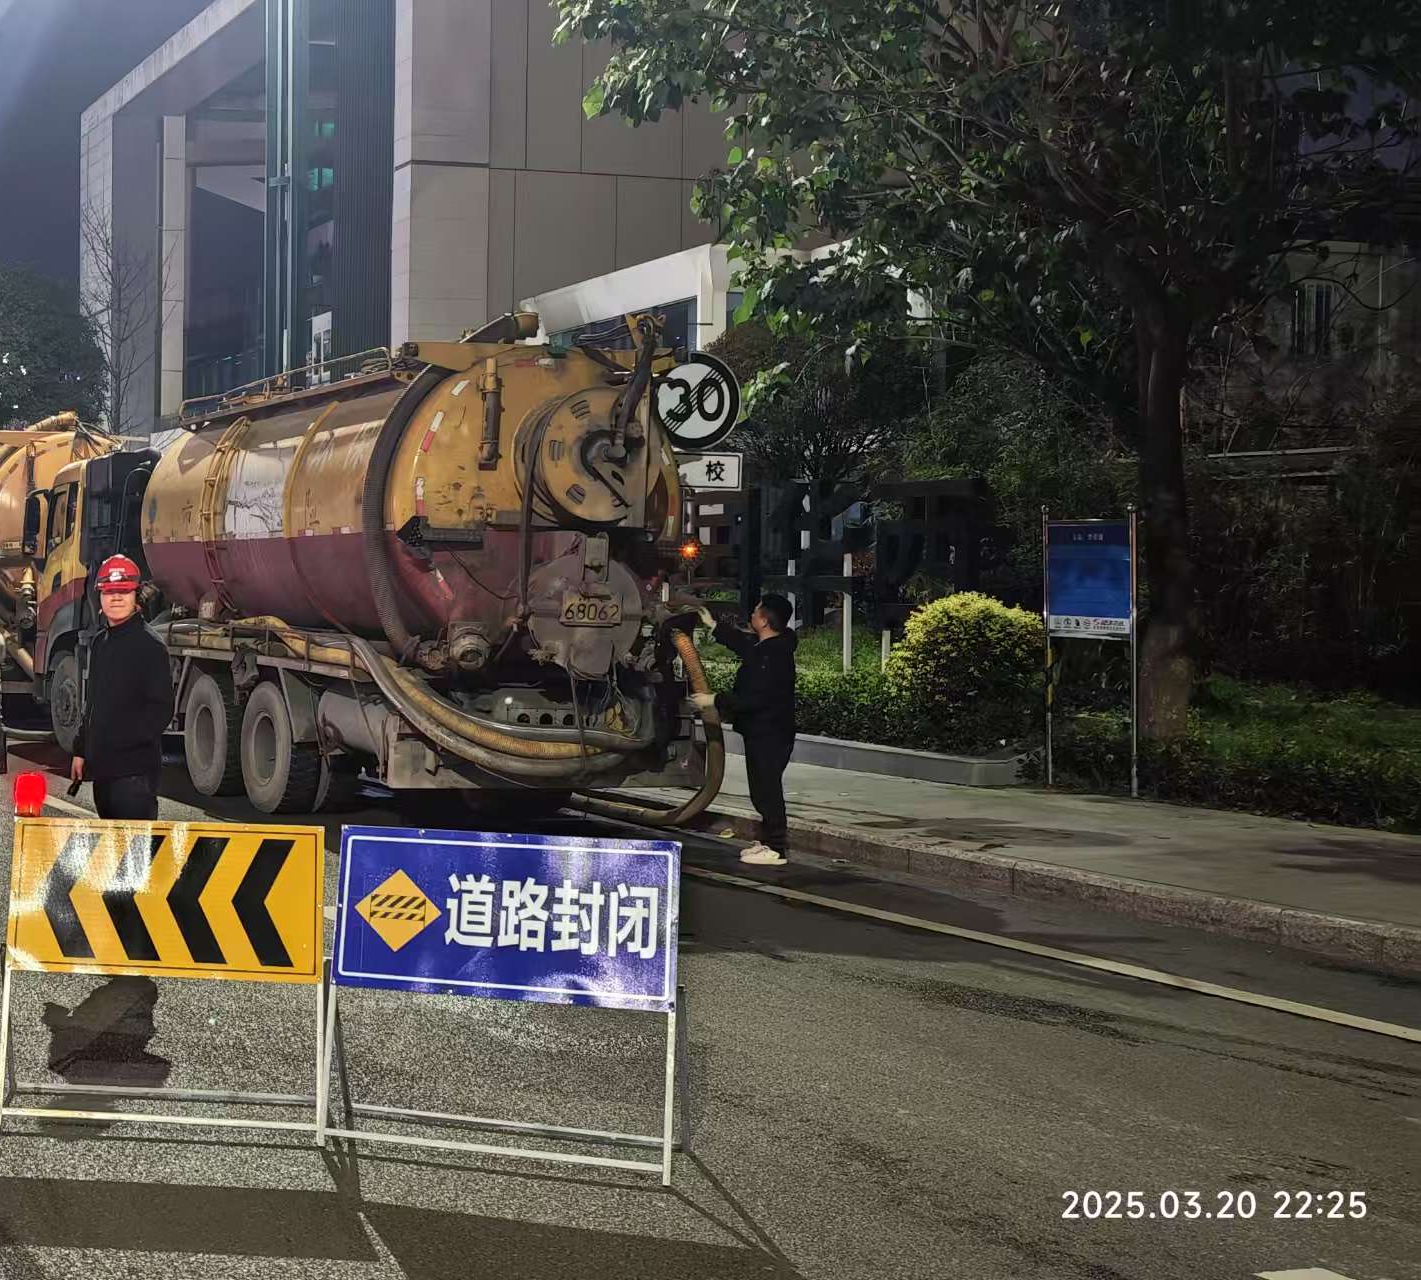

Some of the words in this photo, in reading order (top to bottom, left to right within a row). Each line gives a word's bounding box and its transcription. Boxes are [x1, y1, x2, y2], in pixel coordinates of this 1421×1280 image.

[667, 378, 725, 422] 30
[705, 460, 725, 482] 校
[564, 603, 619, 621] 68062
[444, 873, 659, 959] 道路封闭
